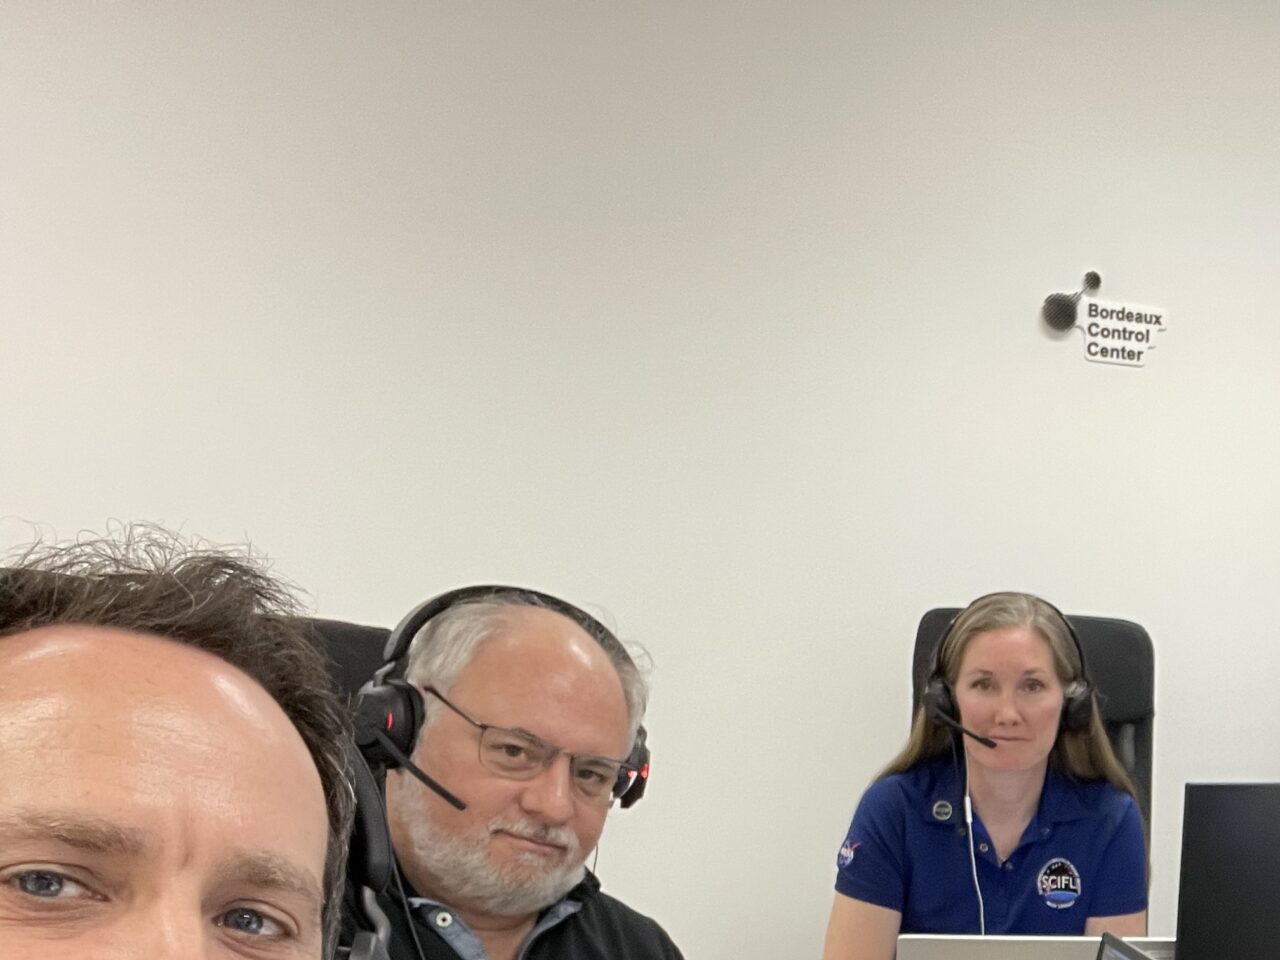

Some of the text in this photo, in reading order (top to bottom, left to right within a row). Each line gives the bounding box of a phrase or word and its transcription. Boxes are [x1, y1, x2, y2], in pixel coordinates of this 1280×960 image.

[1088, 303, 1162, 326] Bordeaux
[1087, 323, 1150, 343] Control
[1087, 342, 1144, 361] Center
